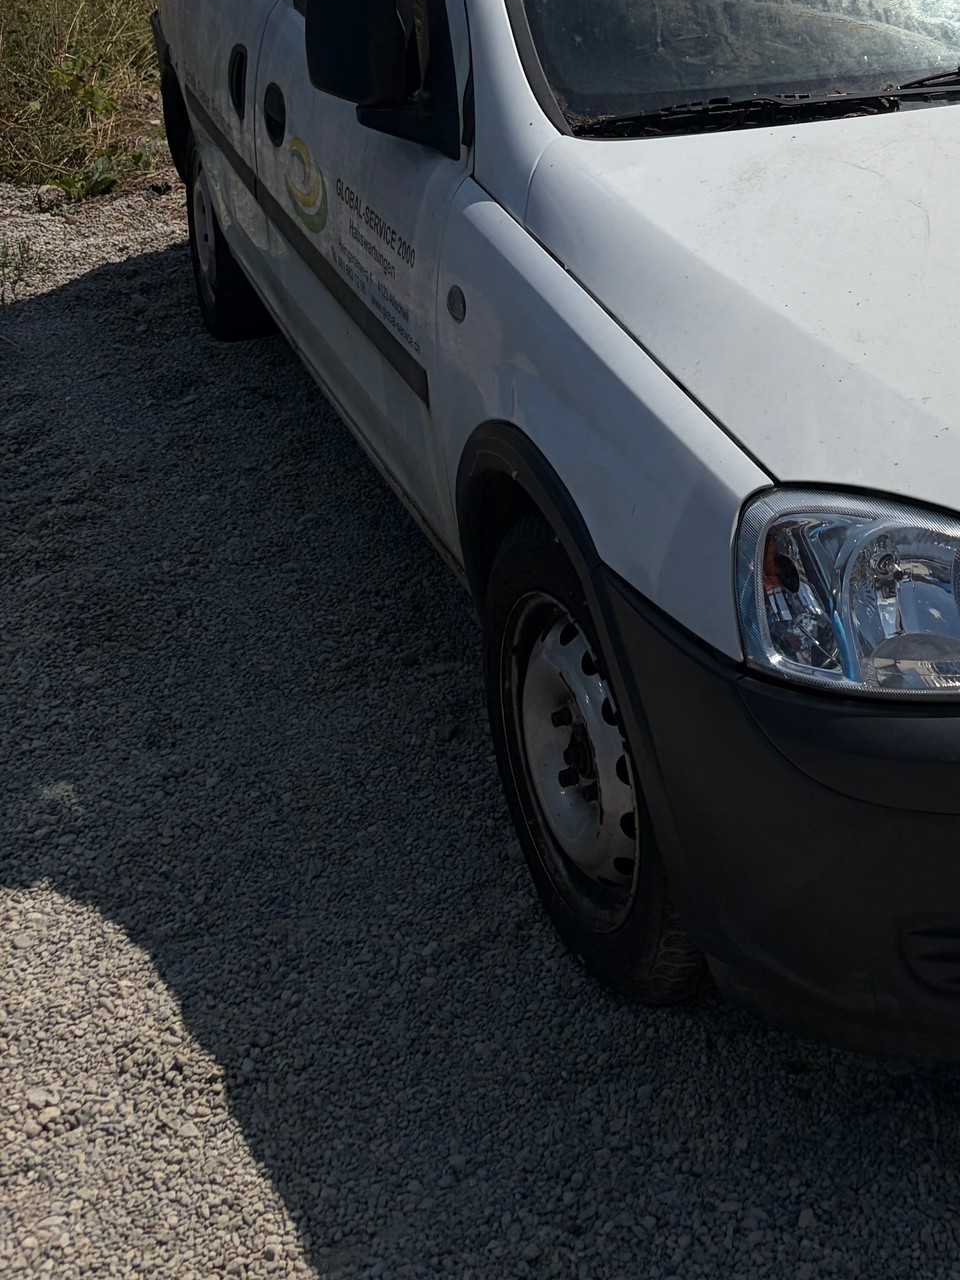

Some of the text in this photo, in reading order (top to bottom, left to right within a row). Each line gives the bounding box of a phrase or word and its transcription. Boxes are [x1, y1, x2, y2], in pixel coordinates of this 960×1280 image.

[336, 178, 396, 250] GLOBAL-SERVICE
[397, 236, 416, 268] 2000
[349, 219, 396, 280] Hauswartungen
